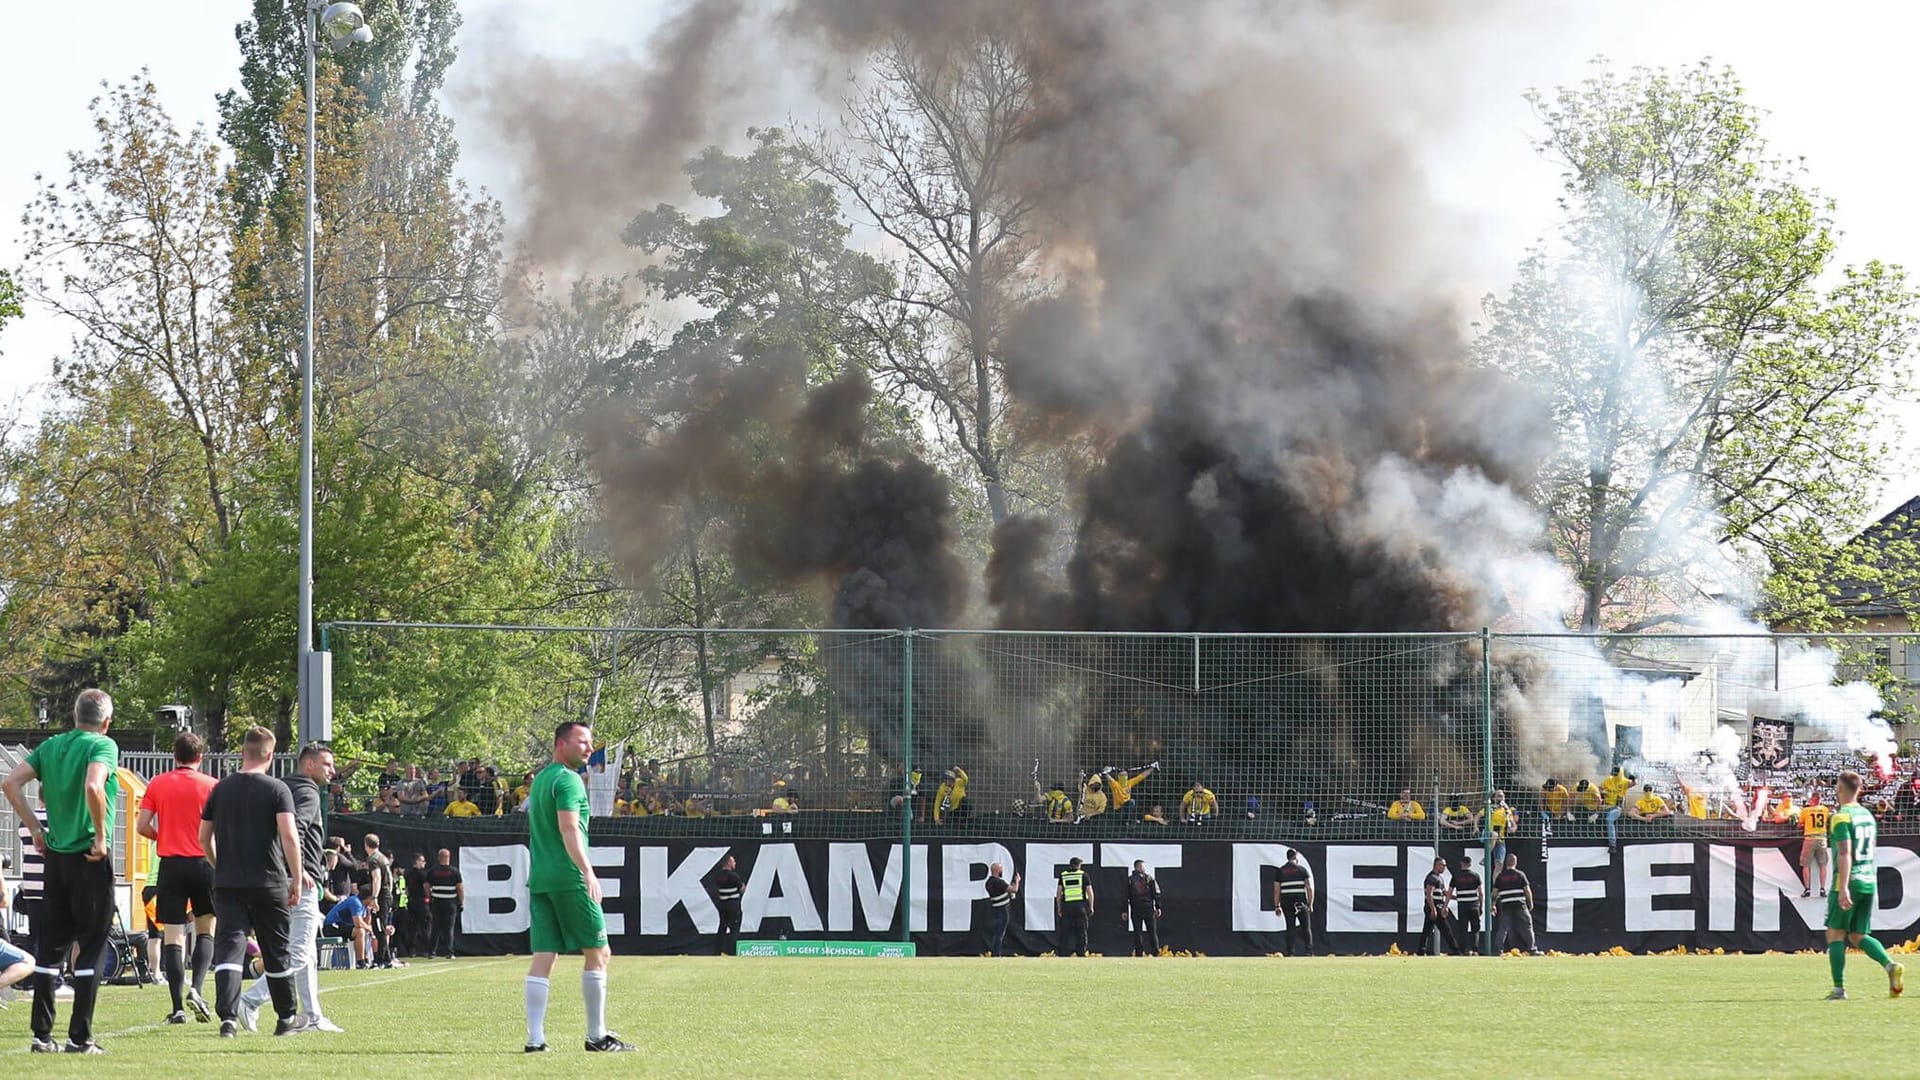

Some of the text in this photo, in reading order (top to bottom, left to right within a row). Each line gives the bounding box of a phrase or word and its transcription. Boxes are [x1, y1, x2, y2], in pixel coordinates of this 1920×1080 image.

[1810, 813, 1824, 828] 13
[786, 946, 797, 954] SO
[798, 946, 820, 954] GEHT
